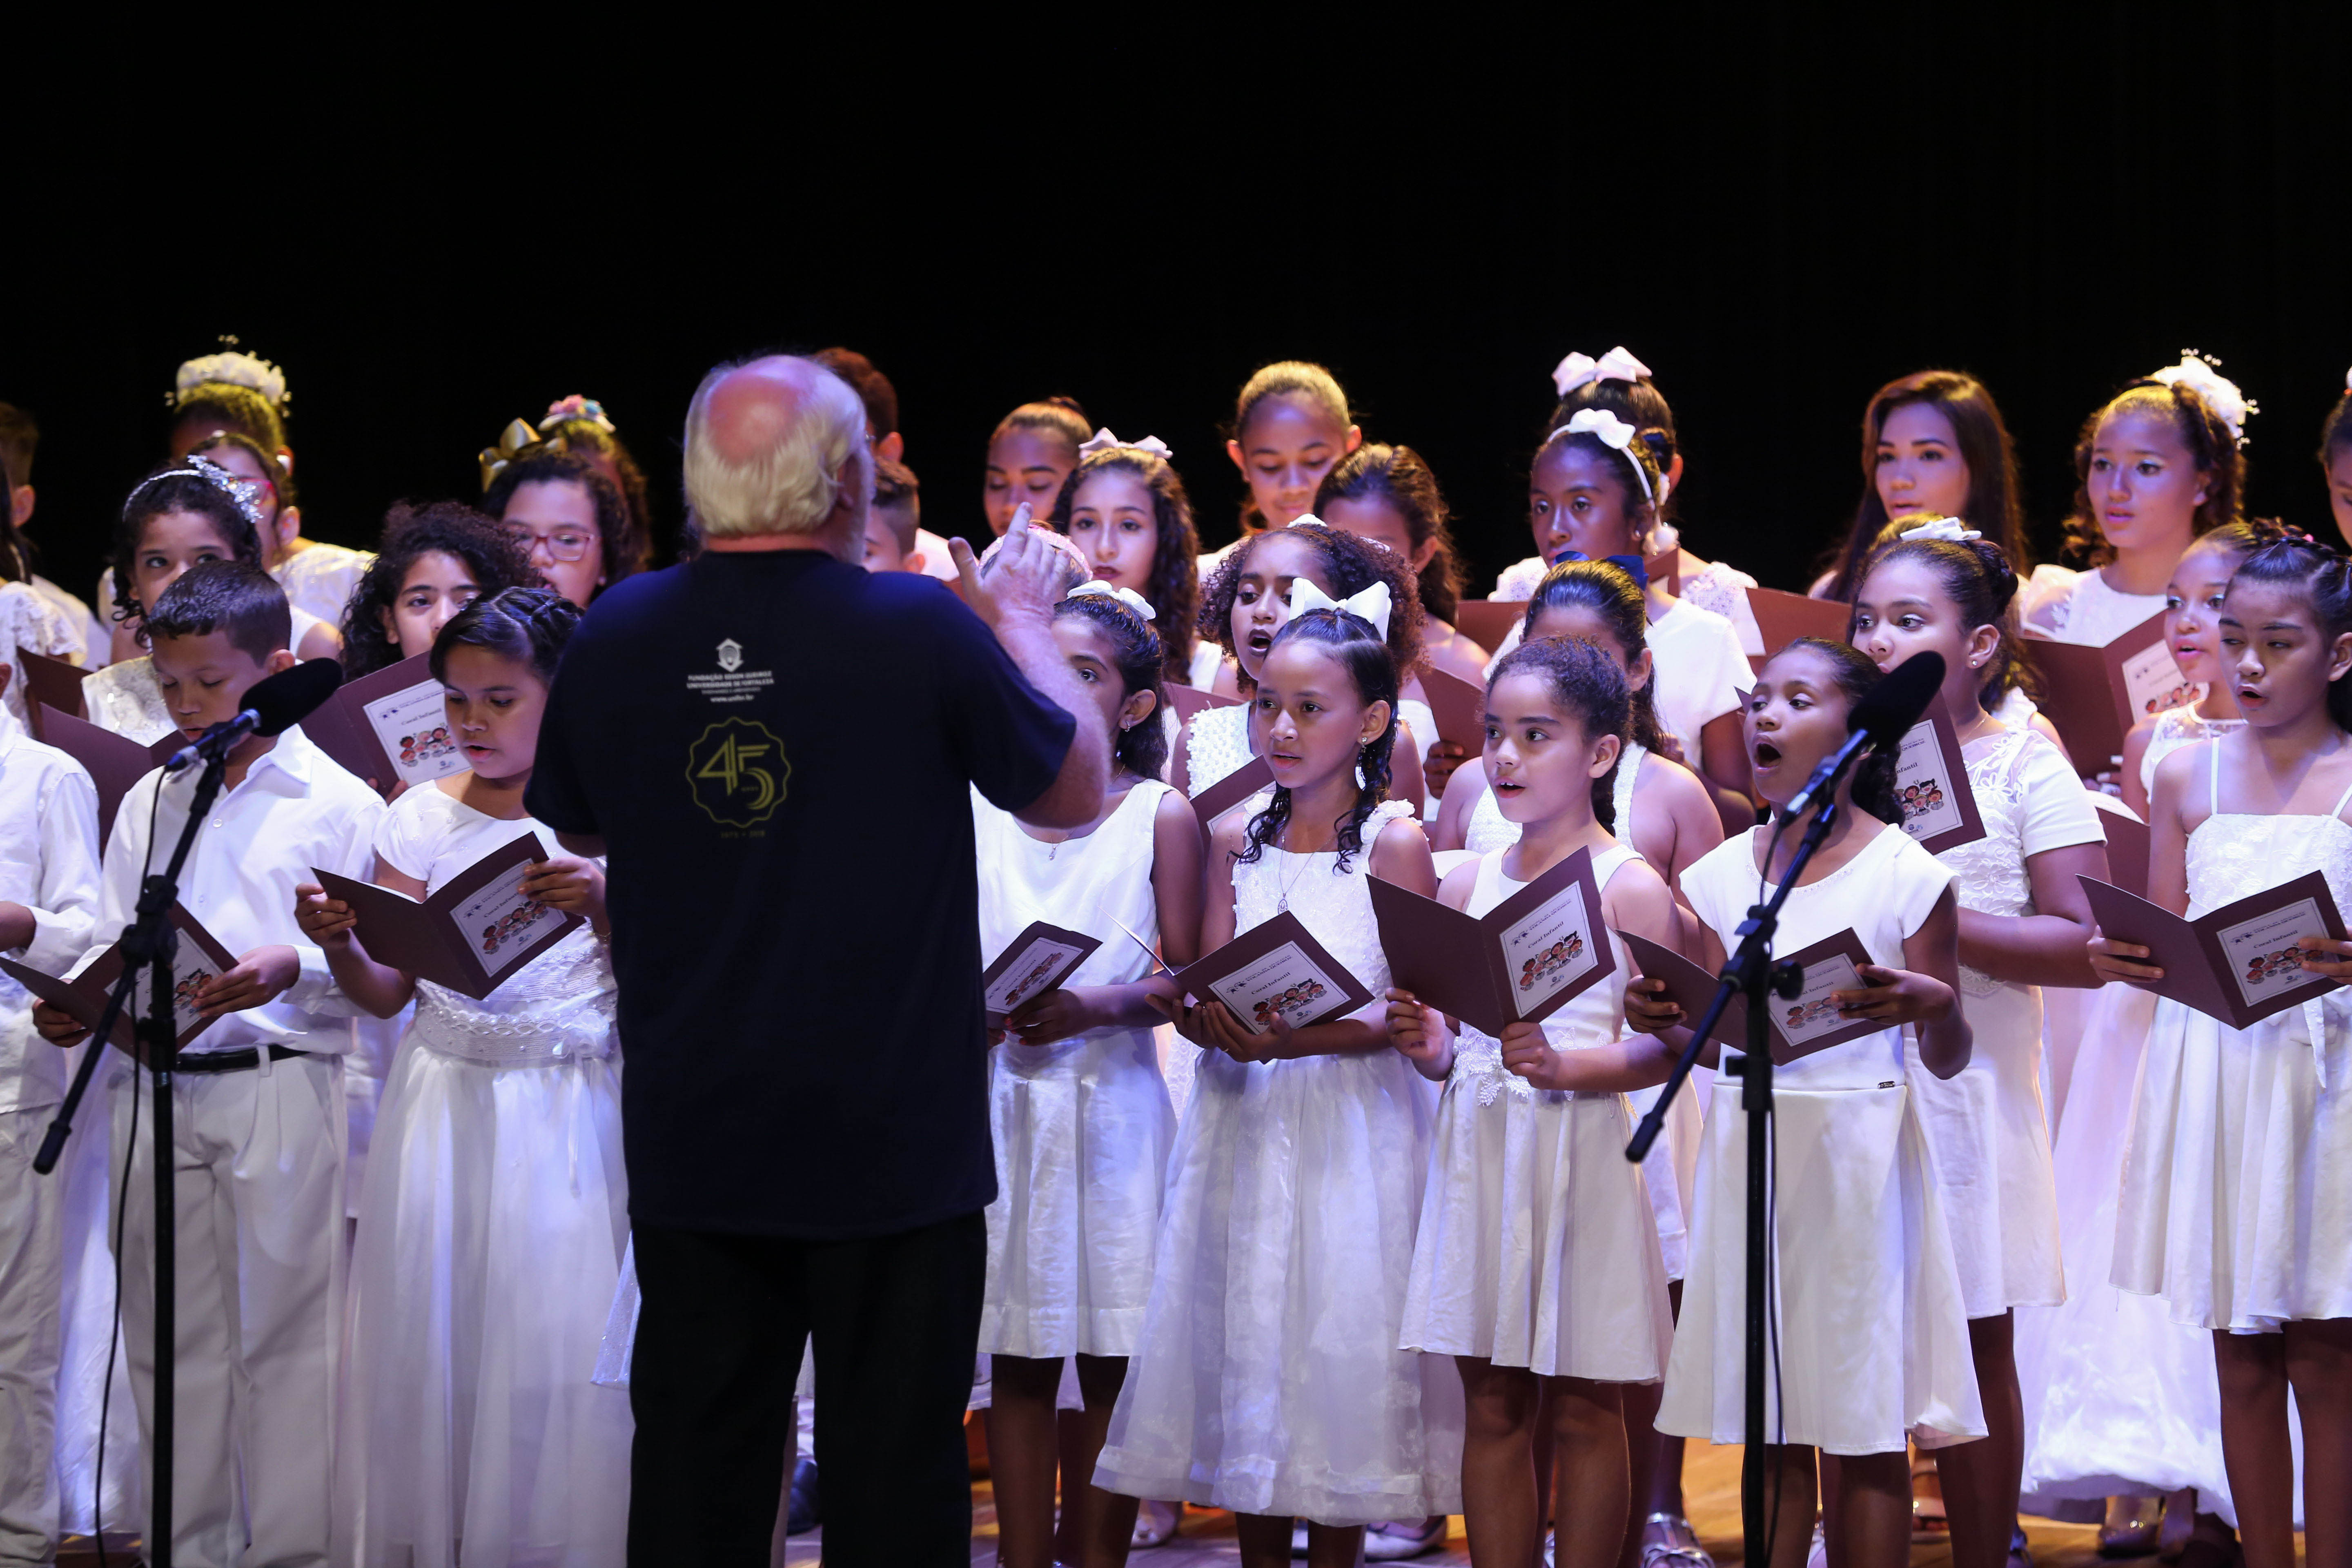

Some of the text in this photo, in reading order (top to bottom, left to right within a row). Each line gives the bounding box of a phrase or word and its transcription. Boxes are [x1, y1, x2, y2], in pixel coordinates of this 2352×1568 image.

[696, 733, 775, 810] 45
[1896, 762, 1918, 773] nfantil
[1528, 921, 1564, 948] Coral Infantil
[2254, 930, 2298, 948] Coral Infantil
[1251, 972, 1291, 995] Coral Infantil
[1809, 981, 1834, 992] Infantil
